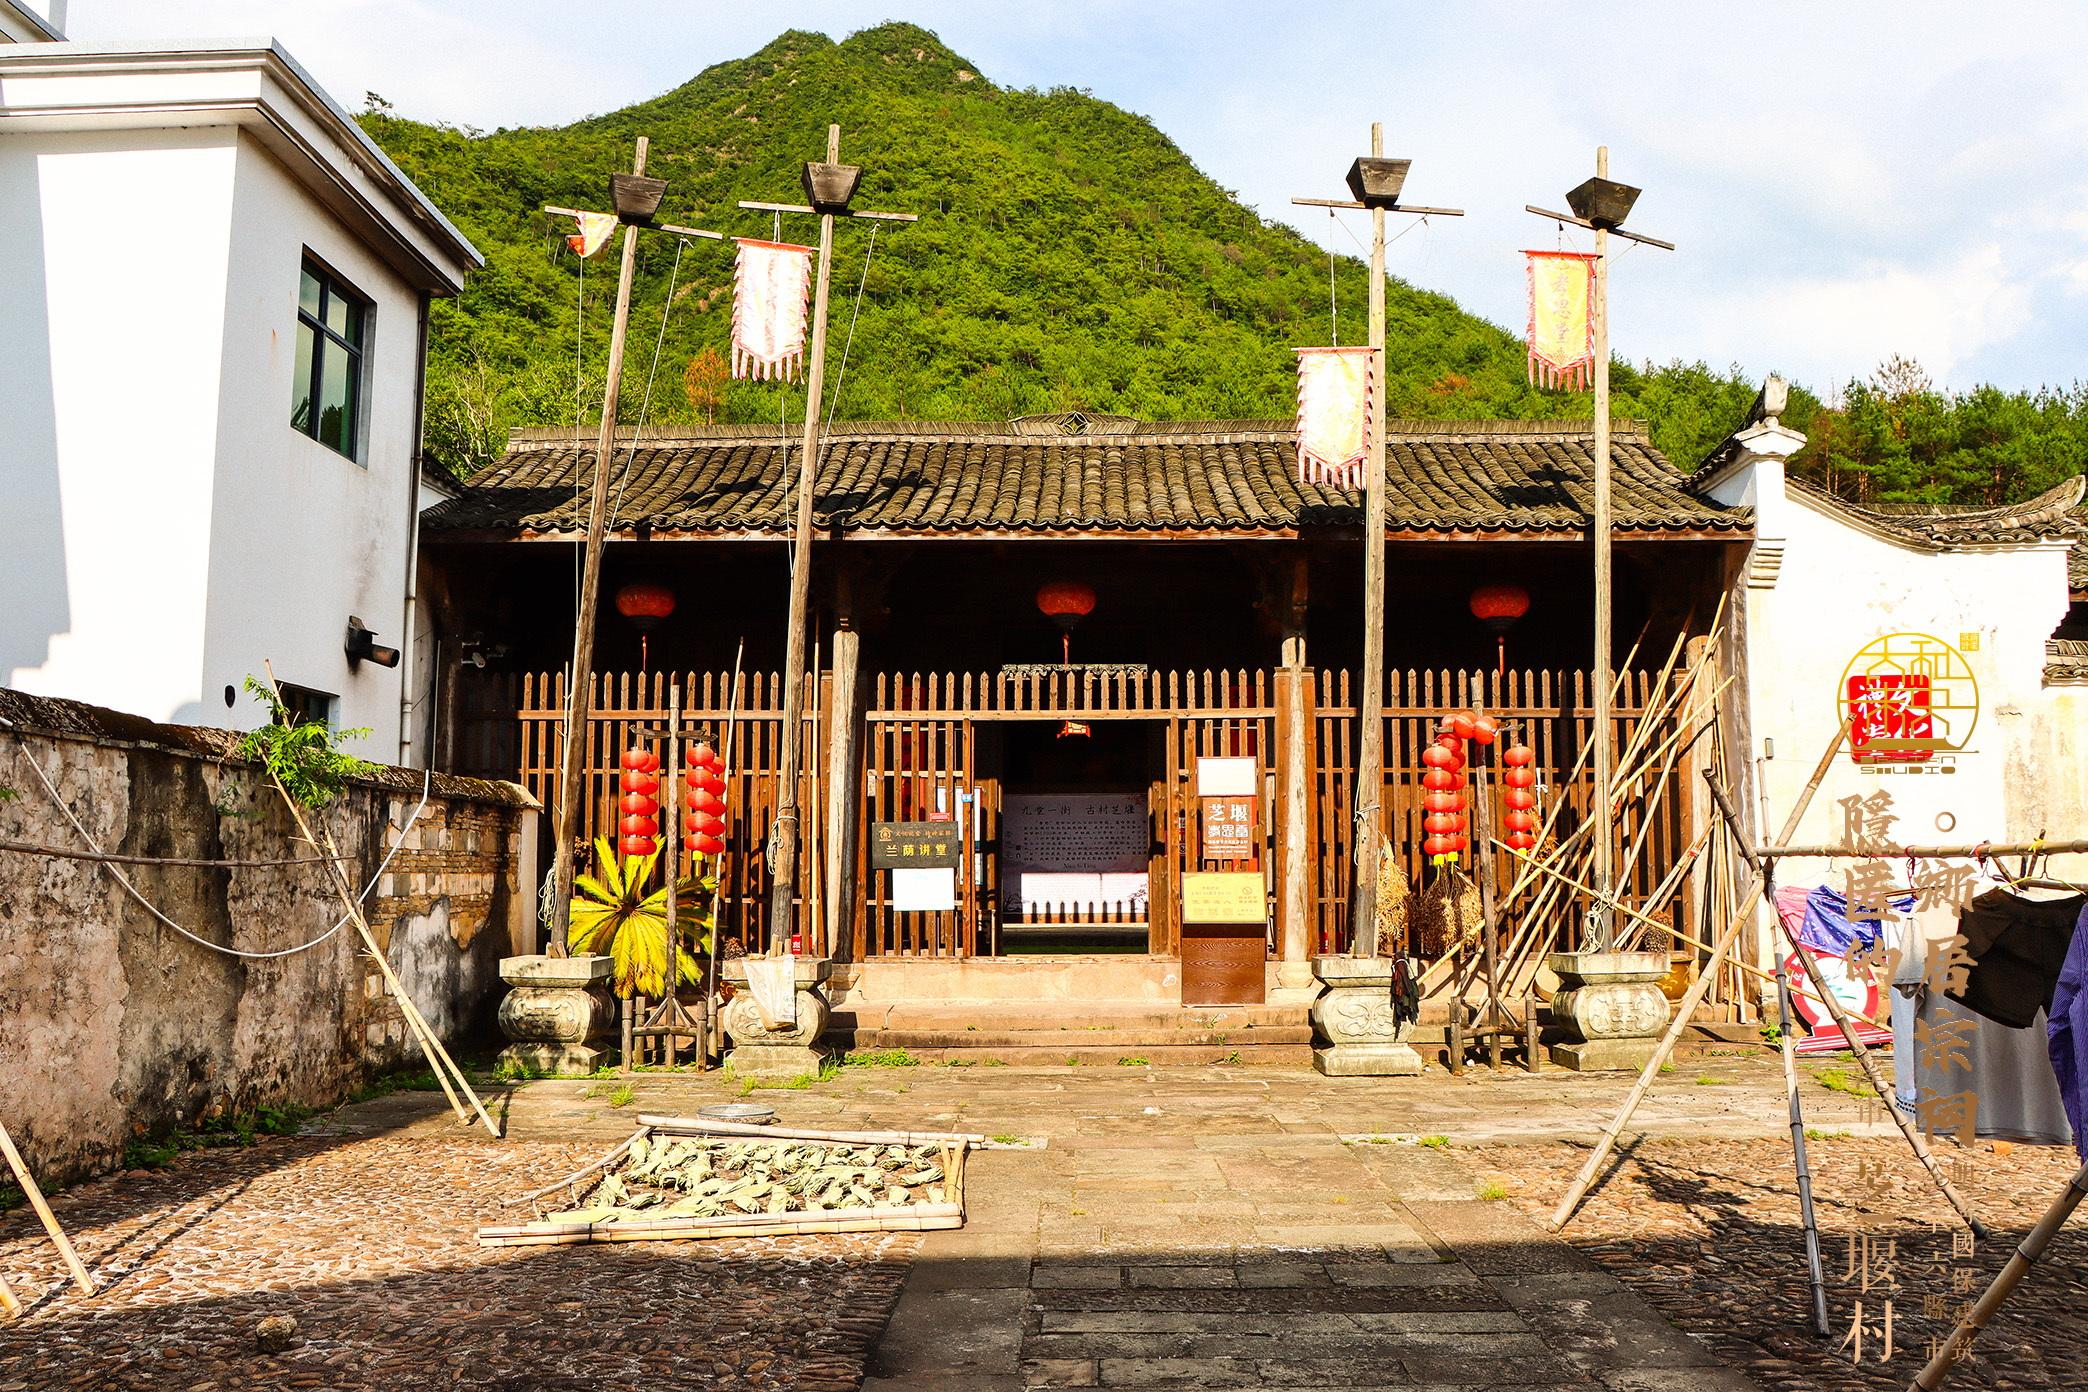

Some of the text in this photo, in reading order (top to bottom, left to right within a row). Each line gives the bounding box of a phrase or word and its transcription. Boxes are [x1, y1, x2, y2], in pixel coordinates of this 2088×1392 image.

[1207, 803, 1249, 822] 芝堰
[886, 843, 949, 857] 兰荫讲堂
